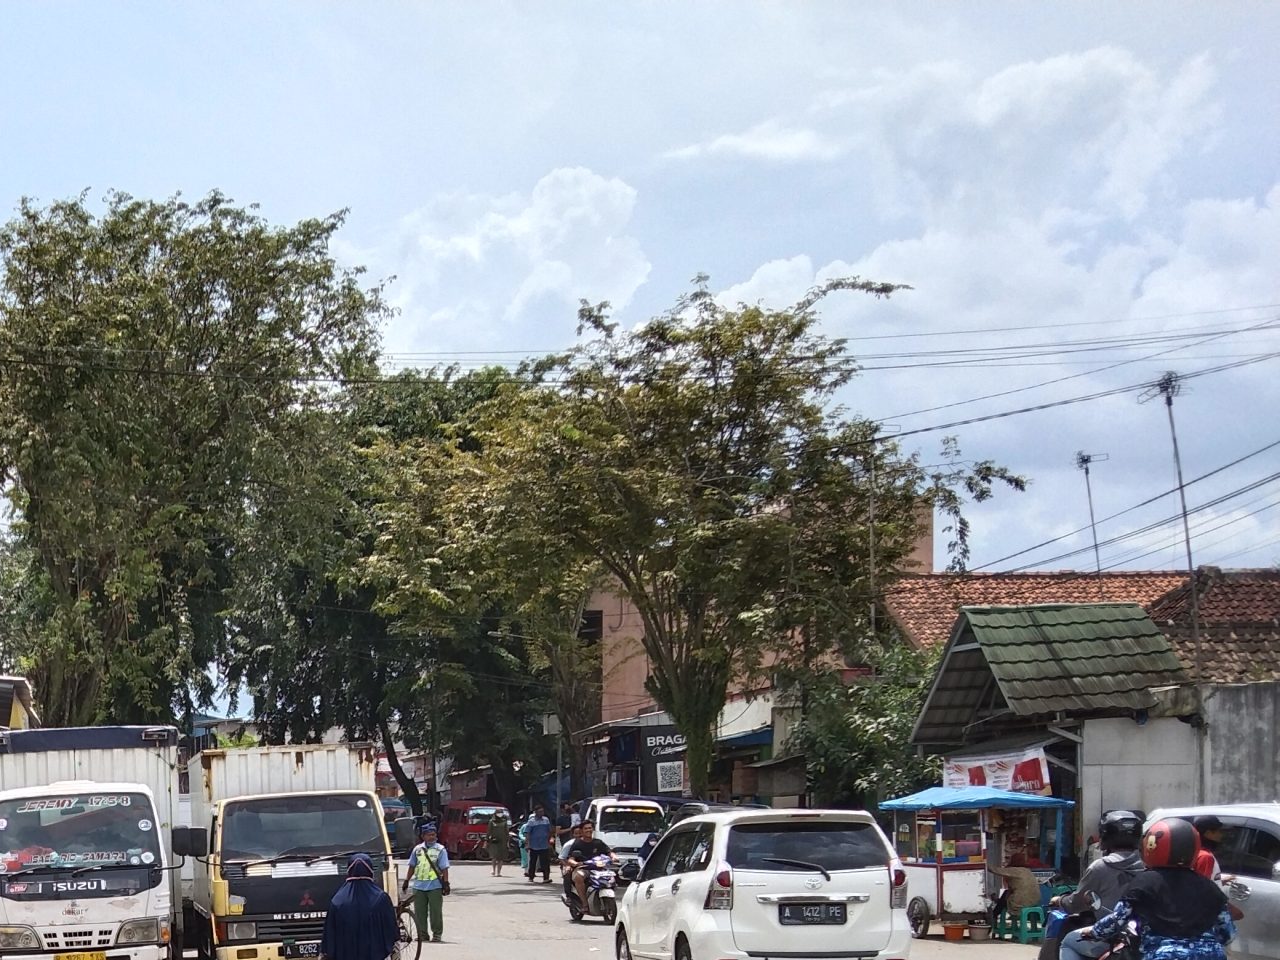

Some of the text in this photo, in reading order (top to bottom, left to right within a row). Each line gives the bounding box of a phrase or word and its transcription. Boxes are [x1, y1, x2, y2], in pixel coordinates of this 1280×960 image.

[16, 798, 79, 813] JEREMY
[82, 851, 127, 862] SAMARA
[784, 906, 841, 917] A 1412 PE
[286, 945, 292, 955] A
[299, 943, 318, 954] 8262
